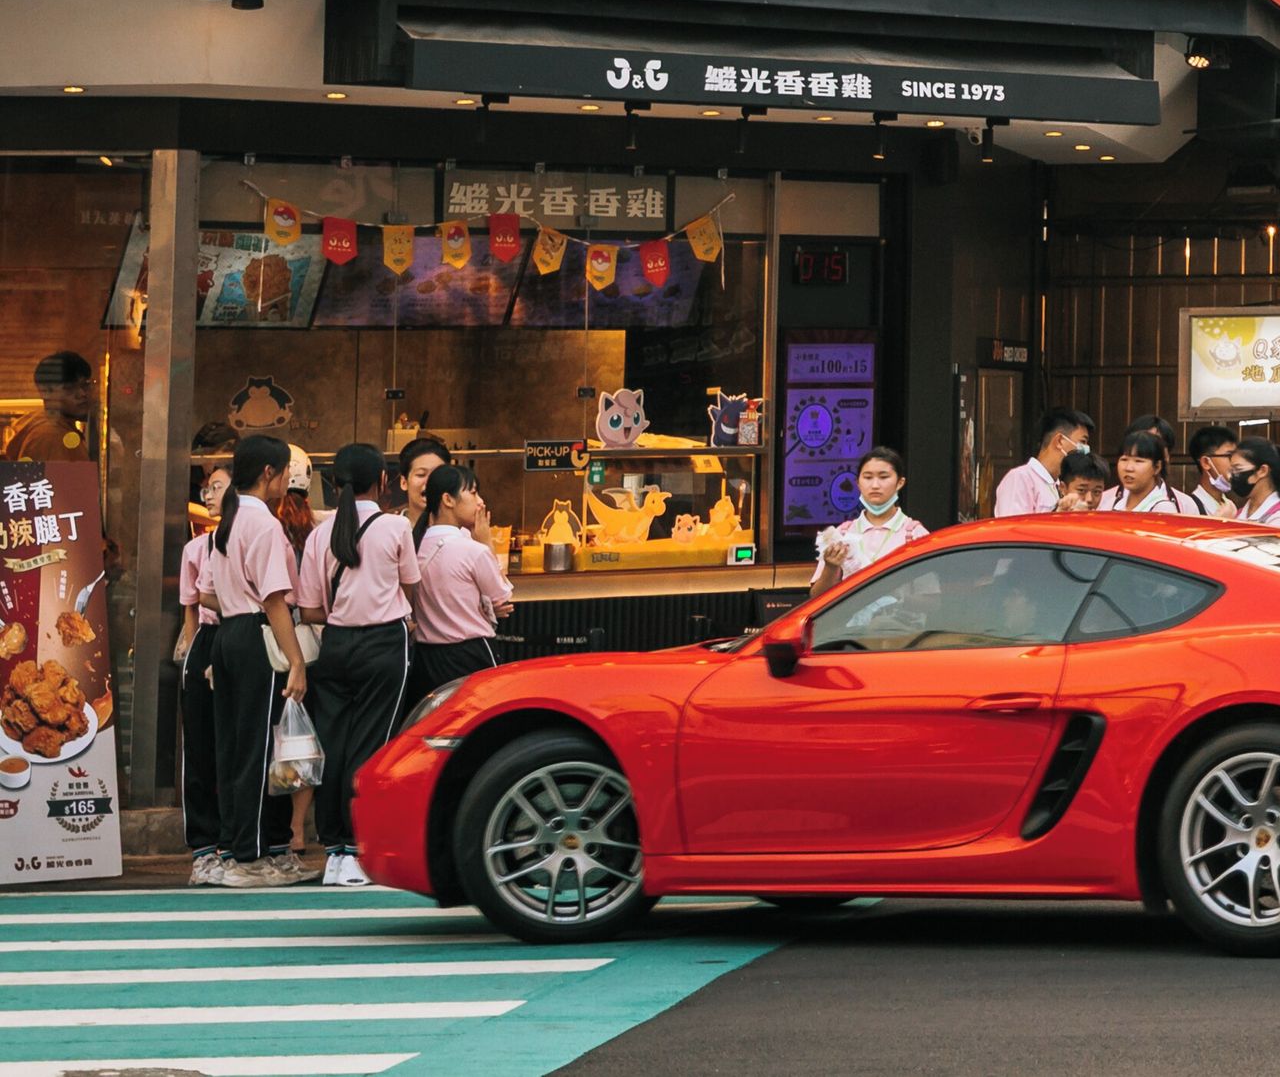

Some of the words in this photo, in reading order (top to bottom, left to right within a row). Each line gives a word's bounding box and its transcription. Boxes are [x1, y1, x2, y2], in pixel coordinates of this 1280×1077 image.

[606, 57, 669, 92] J&G
[704, 66, 873, 100] 繼光香香雞
[901, 80, 956, 100] SINCE
[961, 81, 1006, 103] 1973
[527, 446, 570, 457] PICK-UP
[3, 478, 55, 513] 香香
[64, 799, 96, 815] $165
